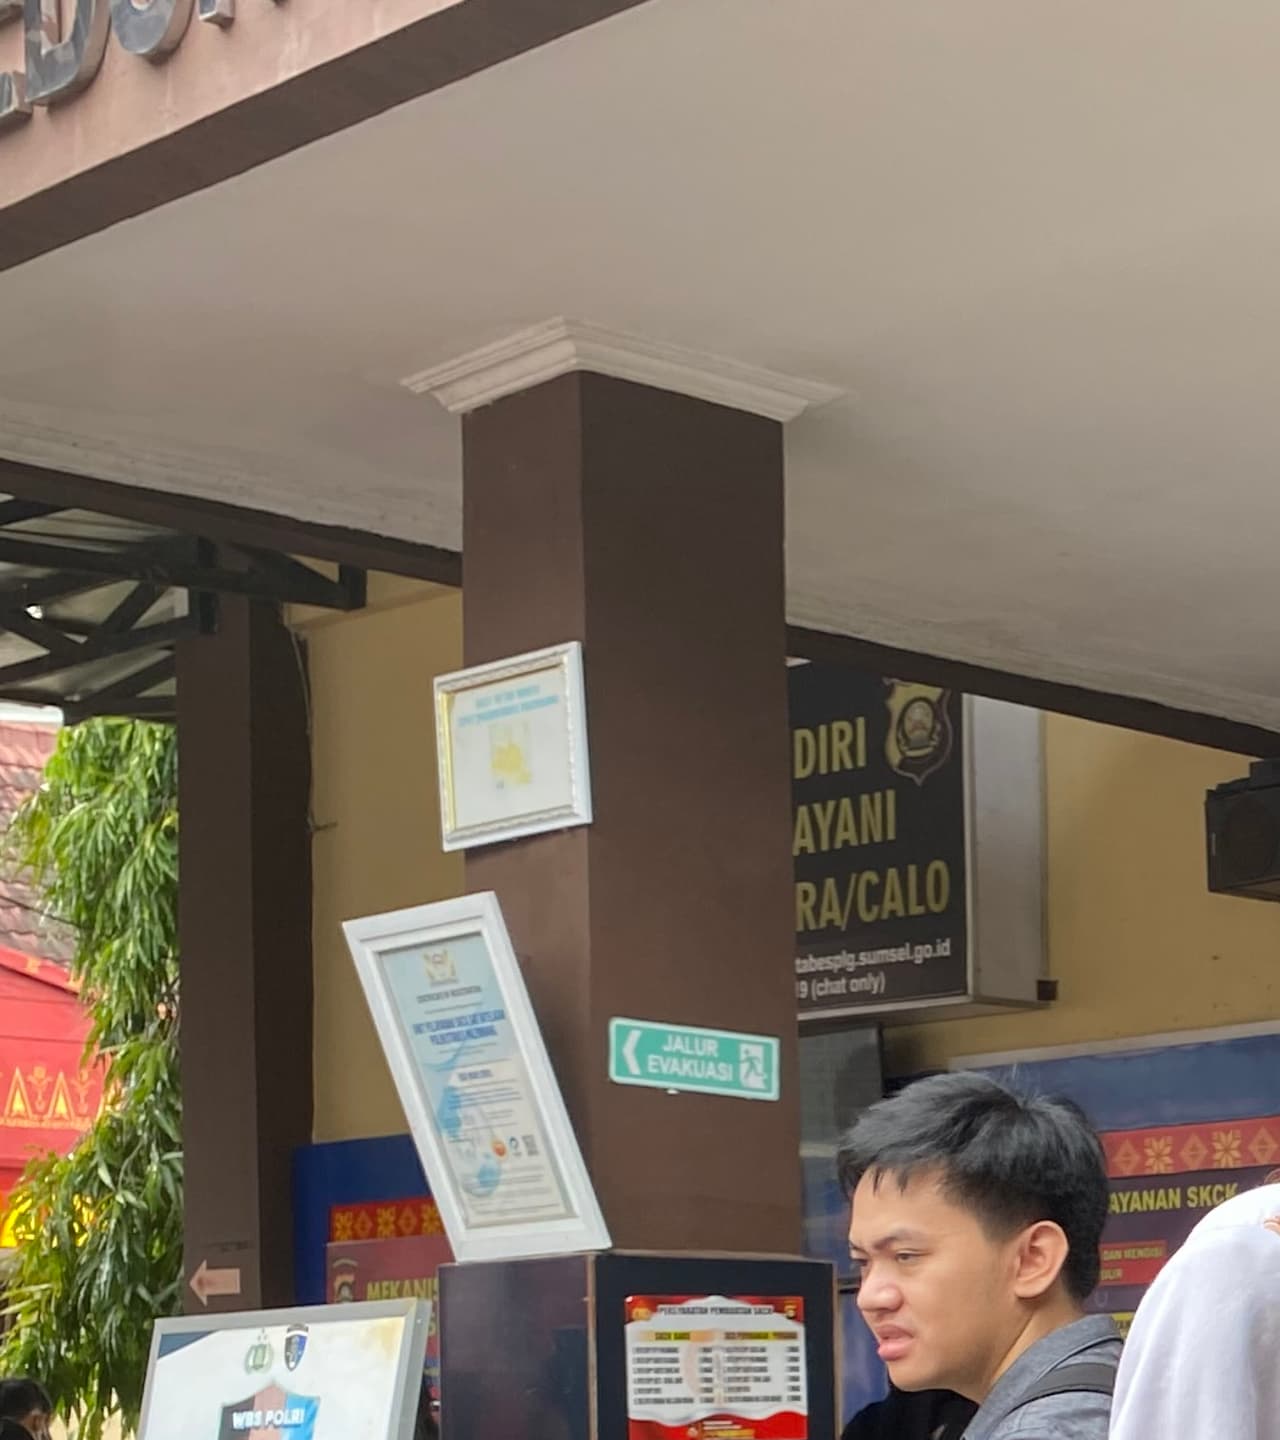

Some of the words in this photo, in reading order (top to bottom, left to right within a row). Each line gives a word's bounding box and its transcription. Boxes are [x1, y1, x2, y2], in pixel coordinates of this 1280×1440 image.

[811, 976, 847, 1001] (chat
[850, 971, 886, 994] only)
[662, 1034, 719, 1057] JALUR
[647, 1054, 734, 1081] EVAKUASI
[1186, 1182, 1239, 1208] SKCK
[232, 1410, 261, 1430] WBS
[264, 1408, 305, 1427] POLRI
